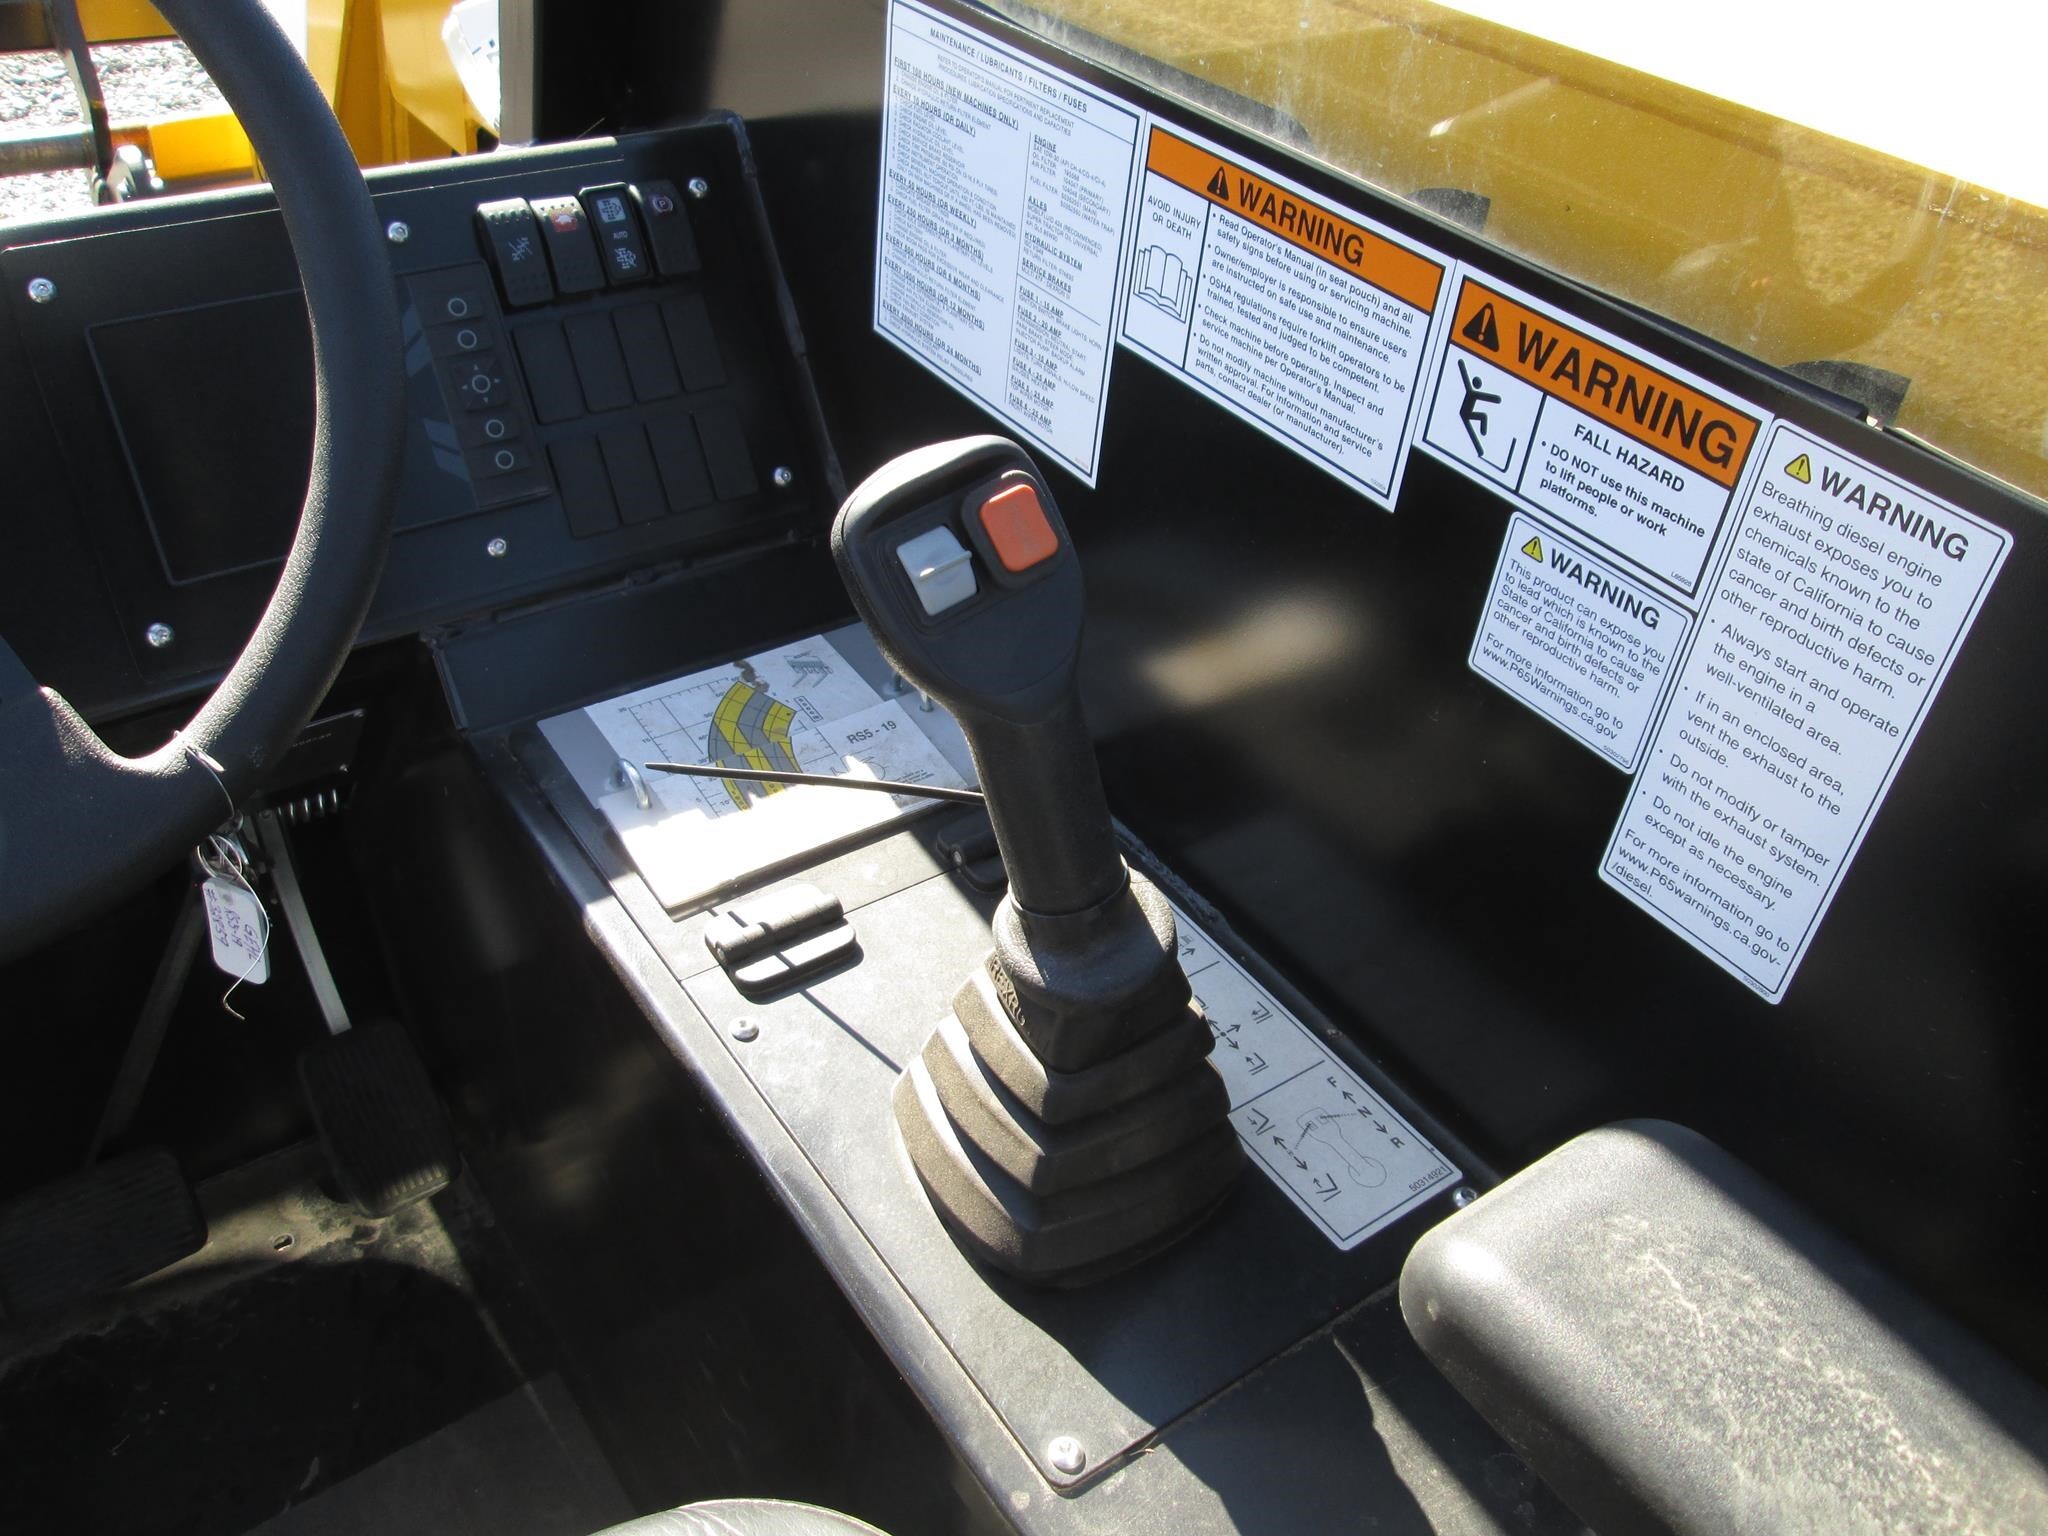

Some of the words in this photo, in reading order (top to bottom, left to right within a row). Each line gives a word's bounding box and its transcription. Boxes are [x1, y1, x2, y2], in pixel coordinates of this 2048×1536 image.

[929, 27, 975, 57] MAINTENANCE
[980, 53, 1022, 81] LUBRICANTS
[1028, 76, 1057, 98] FILTERS
[1062, 93, 1087, 113] FUSES
[1147, 194, 1170, 213] AVOID
[1172, 207, 1201, 229] INJURY
[1152, 211, 1163, 224] OR
[1165, 218, 1191, 240] DEATH
[1239, 177, 1364, 267] WARNING
[1216, 228, 1240, 247] safety
[1242, 241, 1263, 259] signs
[1265, 251, 1291, 273] before
[1293, 268, 1316, 289] using
[1318, 282, 1328, 292] or
[1329, 288, 1369, 317] servicing
[1371, 311, 1411, 339] machine.
[1219, 213, 1239, 231] Read
[1240, 225, 1282, 254] Operator's
[1283, 247, 1314, 271] Manual
[1315, 264, 1327, 278] (in
[1328, 273, 1347, 289] seat
[1348, 284, 1380, 308] pouch)
[1382, 302, 1400, 316] and
[1401, 312, 1413, 324] all
[1517, 320, 1736, 469] WARNING
[1539, 477, 1597, 516] platforms.
[1545, 460, 1557, 474] to
[1559, 467, 1575, 484] lift
[1576, 480, 1617, 508] people
[1619, 504, 1634, 516] or
[1636, 512, 1667, 536] work
[1550, 443, 1569, 461] DO
[1570, 455, 1599, 477] NOT
[1600, 473, 1622, 491] use
[1624, 485, 1648, 506] this
[1650, 501, 1704, 537] machine
[1573, 423, 1611, 455] FALL
[1615, 445, 1684, 492] HAZARD
[1753, 506, 1812, 544] exhaust
[1814, 539, 1879, 580] exposes
[1880, 575, 1912, 599] you
[1916, 591, 1932, 609] to
[1761, 480, 1833, 531] Breathing
[1836, 523, 1885, 555] diesel
[1886, 550, 1942, 586] engine
[1821, 465, 1968, 562] WARNING
[1504, 571, 1515, 584] to
[1517, 578, 1541, 600] lead
[1543, 596, 1573, 621] which
[1575, 615, 1586, 629] is
[1587, 622, 1624, 653] known
[1627, 648, 1638, 662] to
[1641, 656, 1660, 675] the
[1510, 558, 1531, 580] This
[1532, 575, 1574, 606] product
[1576, 603, 1597, 621] can
[1599, 617, 1641, 647] expose
[1642, 643, 1665, 662] you
[1551, 547, 1659, 630] WARNING
[1728, 568, 1777, 601] cancer
[1778, 597, 1809, 620] and
[1810, 611, 1844, 641] birth
[1847, 636, 1904, 675] defects
[1907, 671, 1926, 686] or
[1736, 547, 1771, 573] state
[1774, 569, 1791, 583] of
[1793, 576, 1863, 626] California
[1867, 618, 1882, 636] to
[1886, 632, 1934, 665] cause
[1744, 527, 1817, 573] chemicals
[1820, 564, 1871, 603] known
[1874, 596, 1890, 613] to
[1894, 606, 1920, 630] the
[1501, 583, 1528, 608] State
[1530, 604, 1542, 616] of
[1543, 611, 1594, 650] California
[1596, 644, 1607, 658] to
[1609, 655, 1644, 681] cause
[1713, 641, 1735, 663] the
[1738, 659, 1785, 694] engine
[1788, 687, 1802, 704] in
[1805, 701, 1815, 713] a
[1720, 589, 1757, 615] other
[1759, 611, 1849, 670] reproductive
[1852, 662, 1894, 698] harm.
[1720, 623, 1771, 660] Always
[1774, 656, 1807, 682] start
[1808, 678, 1839, 701] and
[1840, 697, 1899, 737] operate
[847, 729, 873, 744] RS5
[881, 720, 897, 731] 19
[1679, 729, 1728, 767] outside.
[1695, 689, 1706, 704] If
[1706, 697, 1719, 714] in
[1721, 710, 1740, 727] an
[1743, 723, 1808, 769] enclosed
[1808, 765, 1843, 796] area,
[1706, 663, 1805, 730] well-ventilated
[1805, 726, 1841, 755] area.
[1669, 753, 1688, 773] Do
[1690, 770, 1713, 790] not
[1714, 786, 1760, 822] modify
[1762, 818, 1778, 832] or
[1780, 827, 1830, 866] tamper
[1687, 709, 1715, 734] vent
[1717, 728, 1739, 749] the
[1742, 747, 1798, 788] exhaust
[1800, 781, 1814, 798] to
[1817, 793, 1840, 815] the
[1644, 814, 1686, 847] except
[1688, 844, 1704, 860] as
[1707, 857, 1775, 910] necessary.
[1652, 795, 1671, 815] Do
[1673, 812, 1695, 831] not
[1696, 825, 1720, 848] idle
[1722, 844, 1744, 865] the
[1747, 863, 1792, 898] engine
[1662, 772, 1687, 795] with
[1689, 790, 1710, 810] the
[1713, 808, 1767, 849] exhaust
[1768, 845, 1819, 886] system.
[1624, 828, 1646, 849] For
[1647, 847, 1679, 874] more
[1682, 869, 1753, 927] information
[1754, 924, 1773, 940] go
[1776, 936, 1789, 952] to
[1327, 1076, 1338, 1088] F
[1357, 1106, 1373, 1118] N
[1390, 1137, 1405, 1149] R
